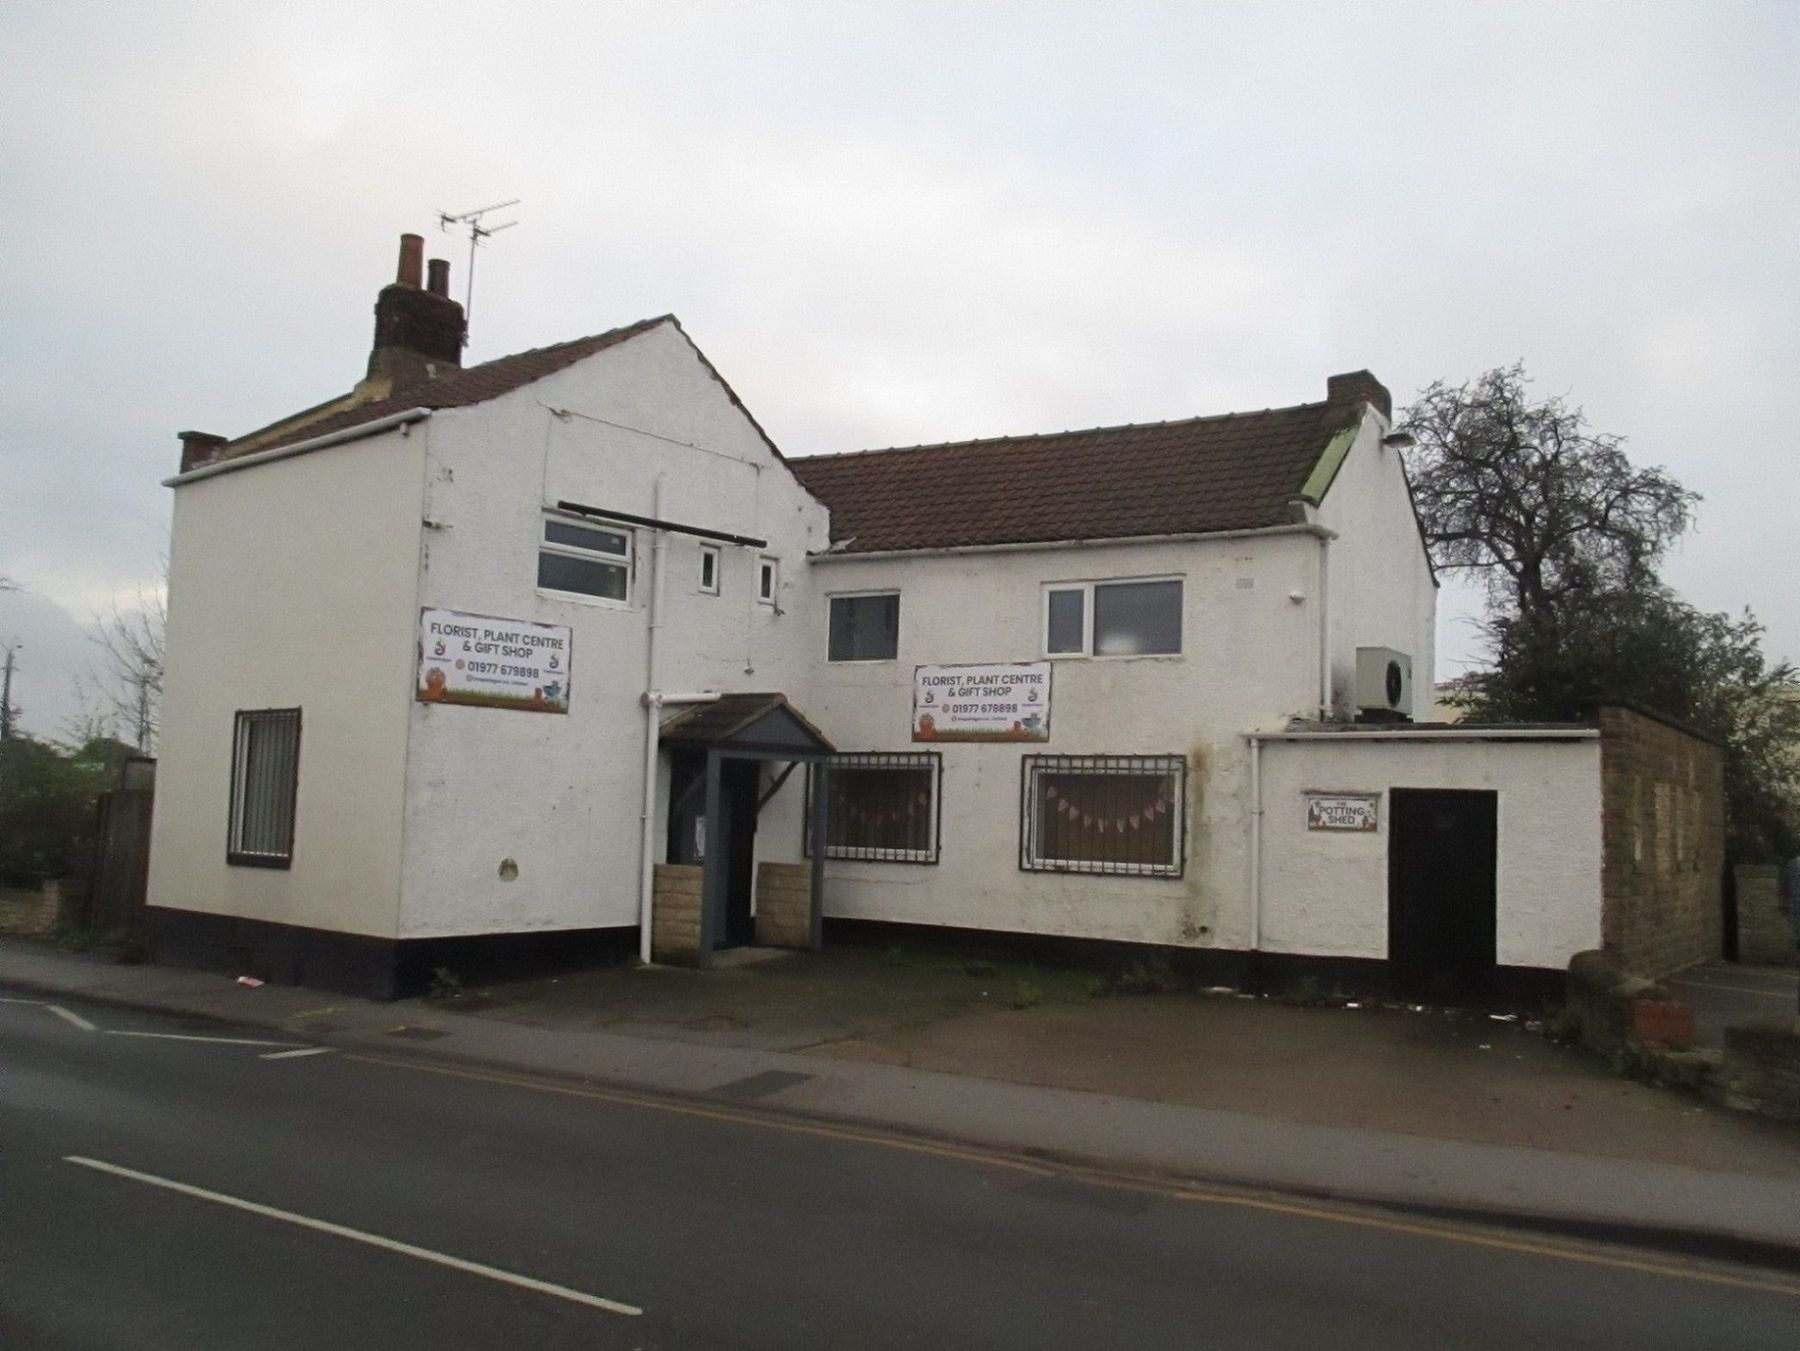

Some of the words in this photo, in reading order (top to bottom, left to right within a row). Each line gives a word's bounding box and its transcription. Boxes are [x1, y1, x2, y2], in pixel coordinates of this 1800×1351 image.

[431, 622, 481, 641] FLORIST,
[484, 630, 520, 645] PLANT
[522, 635, 564, 650] CENTRE
[462, 641, 471, 652] &
[474, 642, 500, 655] GIFT
[502, 645, 533, 659] SHOP
[467, 661, 498, 675] 01977
[922, 675, 964, 687] FLORIST,
[966, 674, 1000, 685] PLANT
[1001, 674, 1043, 685] CENTRE
[948, 688, 956, 697] &
[958, 687, 981, 697] GIFT
[982, 686, 1012, 697] SHOP
[952, 704, 979, 714] 01977
[1319, 807, 1365, 816] POTTING
[1328, 815, 1355, 824] SHED
